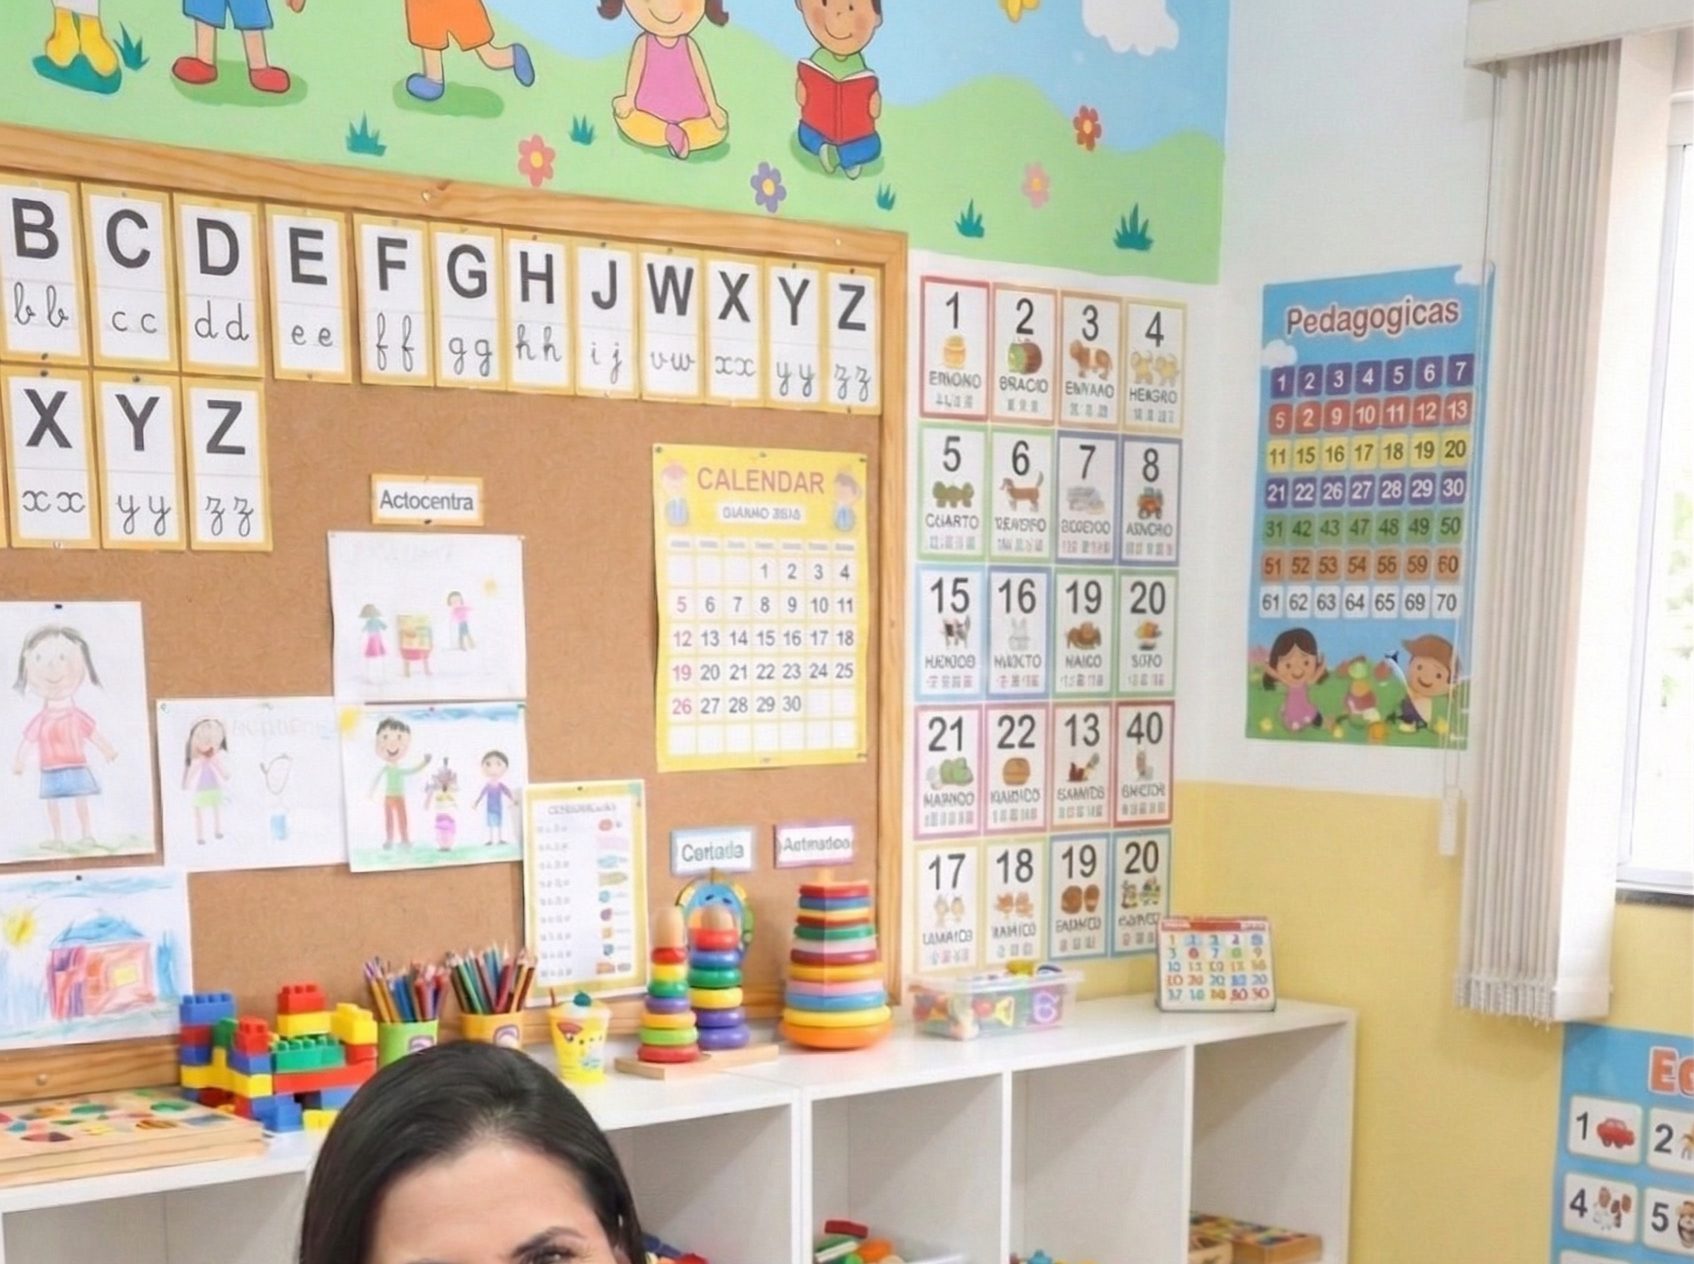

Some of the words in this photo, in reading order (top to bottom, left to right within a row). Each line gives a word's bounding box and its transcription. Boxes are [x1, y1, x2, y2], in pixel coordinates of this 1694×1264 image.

[12, 198, 59, 259] B
[106, 209, 150, 268] C
[197, 218, 239, 276] D
[289, 228, 327, 285] E
[377, 237, 408, 290] F
[446, 244, 488, 299] G
[519, 251, 554, 304] H
[591, 260, 616, 310] J
[647, 263, 694, 316] W
[718, 271, 750, 323] X
[778, 276, 810, 326] Y
[837, 284, 866, 331] Z
[946, 291, 959, 329] 1
[1016, 298, 1034, 335] 2
[1082, 305, 1099, 341] 3
[1145, 312, 1164, 347] 4
[1286, 297, 1459, 338] Pedagogicas
[1278, 375, 1286, 390] 1
[1305, 372, 1314, 389] 2
[1334, 370, 1344, 388] 3
[1363, 368, 1374, 386] 4
[1394, 366, 1404, 384] 5
[1424, 364, 1435, 382] 6
[1456, 362, 1466, 380] 7
[24, 389, 72, 448] X
[115, 394, 160, 451] Y
[206, 400, 246, 455] Z
[1276, 412, 1285, 428] 5
[1303, 409, 1314, 427] 2
[1332, 408, 1342, 425] 9
[1356, 405, 1376, 423] 10
[1386, 404, 1404, 422] 11
[1417, 402, 1436, 421] 12
[1447, 400, 1467, 419] 13
[943, 436, 961, 472] 5
[1012, 440, 1030, 476] 6
[1080, 444, 1096, 480] 7
[1143, 448, 1159, 482] 8
[1269, 449, 1286, 464] 11
[1296, 447, 1315, 464] 15
[1325, 446, 1344, 462] 16
[1354, 444, 1374, 461] 17
[1384, 443, 1403, 460] 18
[1414, 441, 1435, 459] 19
[1445, 440, 1466, 458] 20
[697, 467, 825, 494] CALENDAR
[1267, 485, 1285, 502] 21
[1294, 484, 1314, 501] 22
[1323, 483, 1343, 500] 26
[1352, 482, 1372, 499] 27
[1381, 480, 1402, 498] 28
[1412, 480, 1433, 498] 29
[1443, 479, 1464, 497] 30
[380, 490, 474, 511] Actocentra
[761, 564, 768, 579] 1
[788, 564, 797, 580] 2
[814, 564, 823, 580] 3
[840, 564, 850, 580] 4
[677, 597, 687, 613] 5
[705, 597, 715, 613] 6
[733, 597, 742, 613] 7
[760, 597, 770, 613] 8
[788, 597, 797, 613] 9
[811, 597, 829, 613] 10
[838, 597, 853, 613] 11
[931, 577, 970, 614] 15
[998, 578, 1036, 614] 16
[1066, 580, 1102, 614] 19
[1130, 580, 1166, 615] 20
[1262, 594, 1279, 611] 61
[1289, 594, 1308, 611] 62
[1317, 594, 1336, 611] 63
[1345, 594, 1365, 611] 64
[1375, 594, 1395, 611] 65
[1405, 594, 1426, 611] 69
[1437, 594, 1457, 611] 70
[673, 631, 692, 647] 12
[701, 630, 720, 646] 13
[729, 630, 748, 646] 14
[756, 630, 775, 646] 15
[783, 630, 802, 646] 16
[810, 630, 829, 646] 17
[837, 630, 854, 646] 18
[672, 665, 692, 680] 19
[700, 665, 720, 680] 20
[729, 664, 748, 680] 21
[756, 664, 775, 679] 22
[782, 664, 801, 679] 23
[809, 663, 828, 679] 24
[835, 663, 853, 678] 25
[672, 698, 692, 715] 26
[700, 698, 720, 714] 27
[728, 697, 748, 713] 28
[756, 697, 775, 713] 29
[782, 696, 801, 712] 30
[928, 716, 963, 752] 21
[997, 714, 1036, 749] 22
[1064, 713, 1100, 747] 13
[1126, 712, 1162, 745] 40
[929, 853, 966, 890] 17
[996, 849, 1034, 884] 18
[1061, 844, 1097, 879] 19
[1124, 841, 1159, 874] 20
[1576, 1112, 1589, 1140] 1
[1654, 1123, 1674, 1153] 2
[1569, 1189, 1588, 1218] 4
[1651, 1203, 1669, 1232] 5
